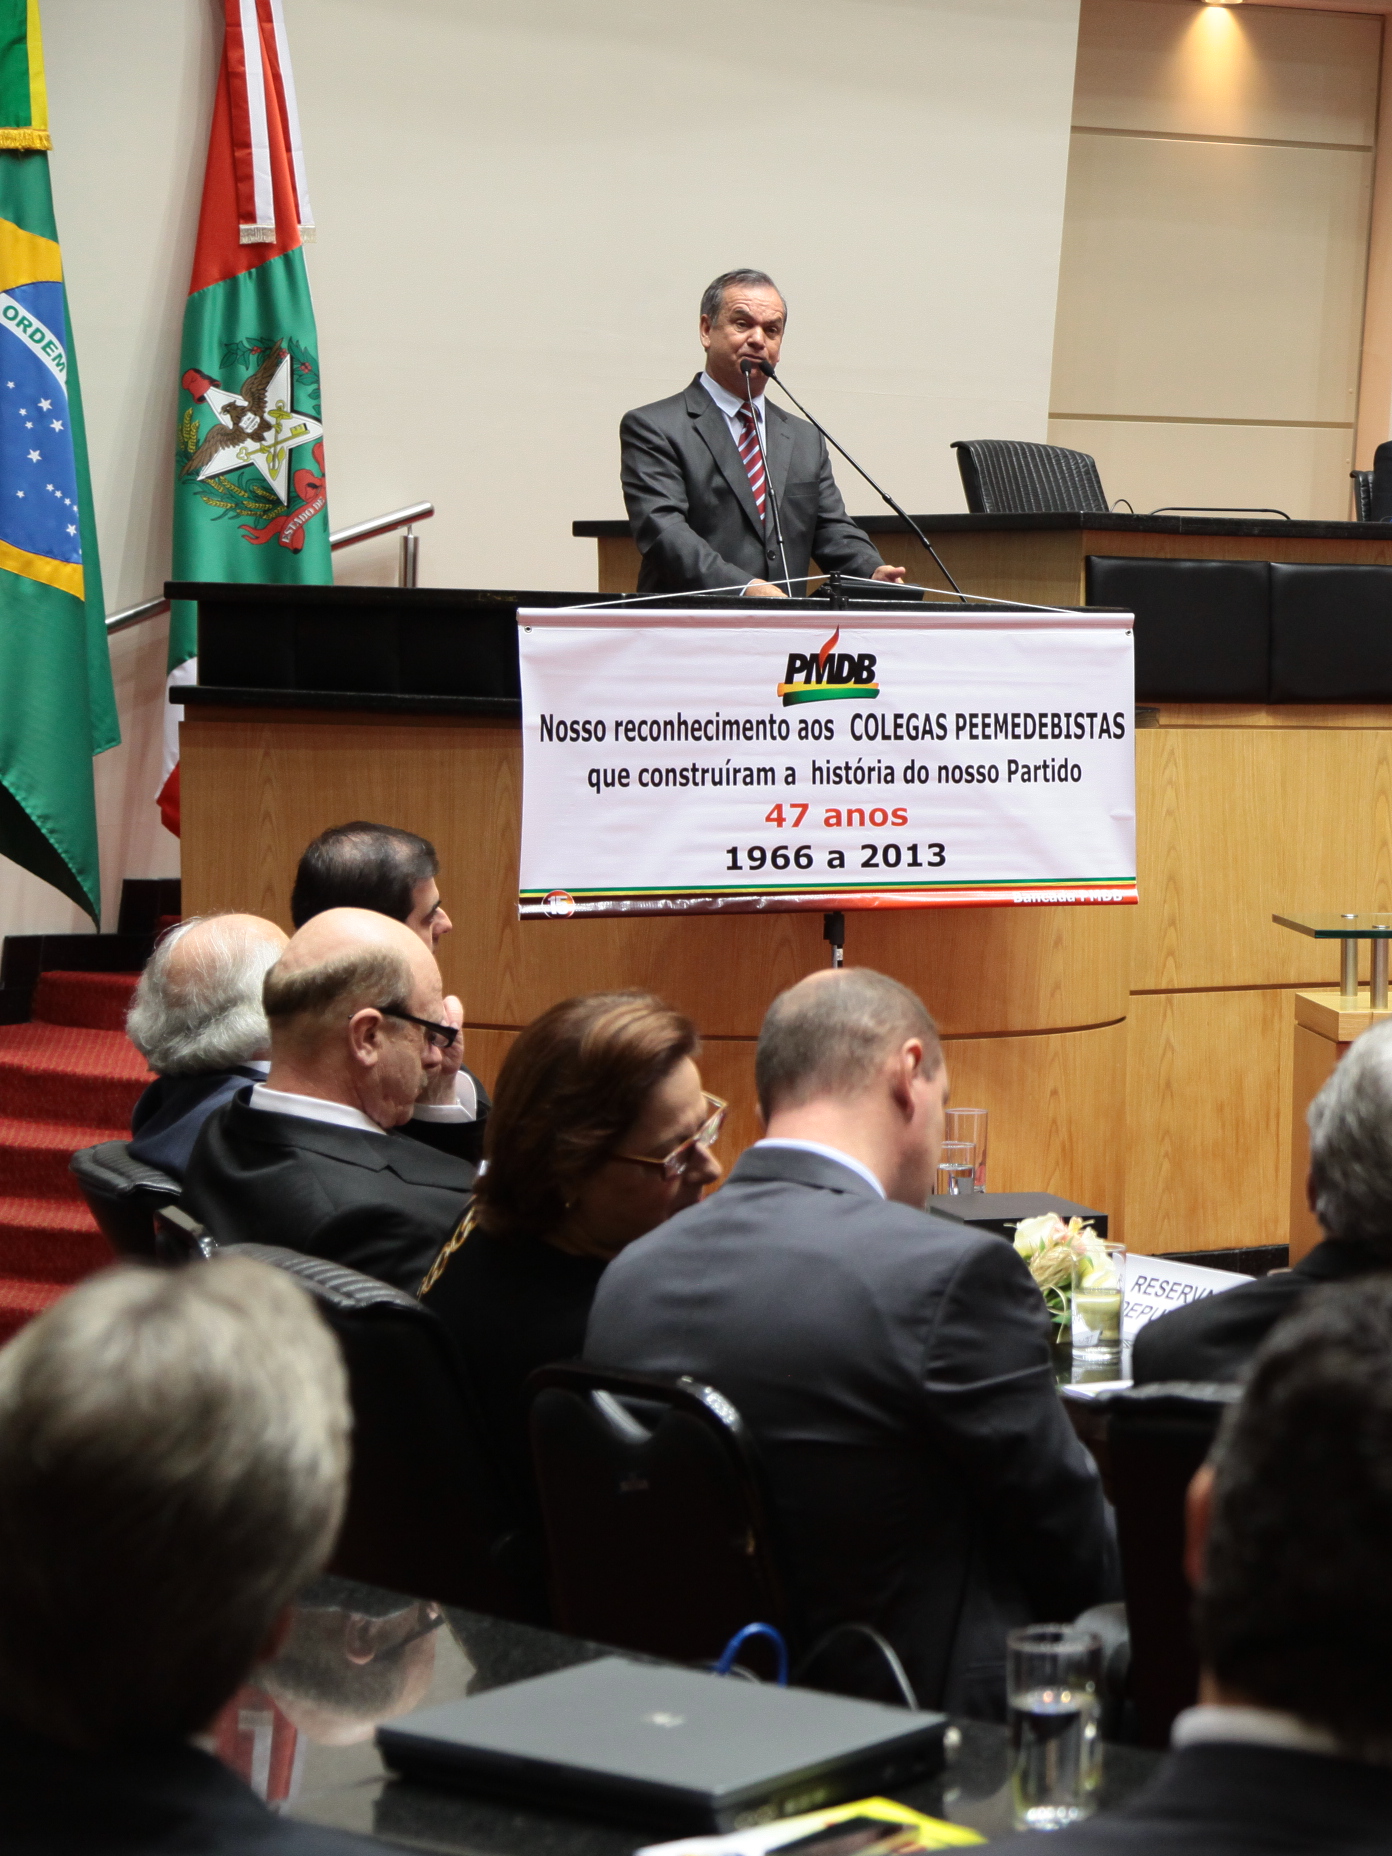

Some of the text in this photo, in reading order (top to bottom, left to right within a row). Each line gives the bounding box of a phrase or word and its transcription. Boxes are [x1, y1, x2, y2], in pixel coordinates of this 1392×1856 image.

[2, 305, 67, 373] ORDEM
[282, 507, 315, 543] ESTADO
[784, 651, 878, 685] PMDB
[541, 711, 1126, 743] Nosso reconhecimento aos COLEGAS PEEMEDEBISTAS
[587, 757, 1082, 795] que construíram a história do nosso Partido
[765, 803, 909, 829] 47 anos
[727, 842, 946, 871] 1966 a 2013
[547, 895, 569, 915] 15
